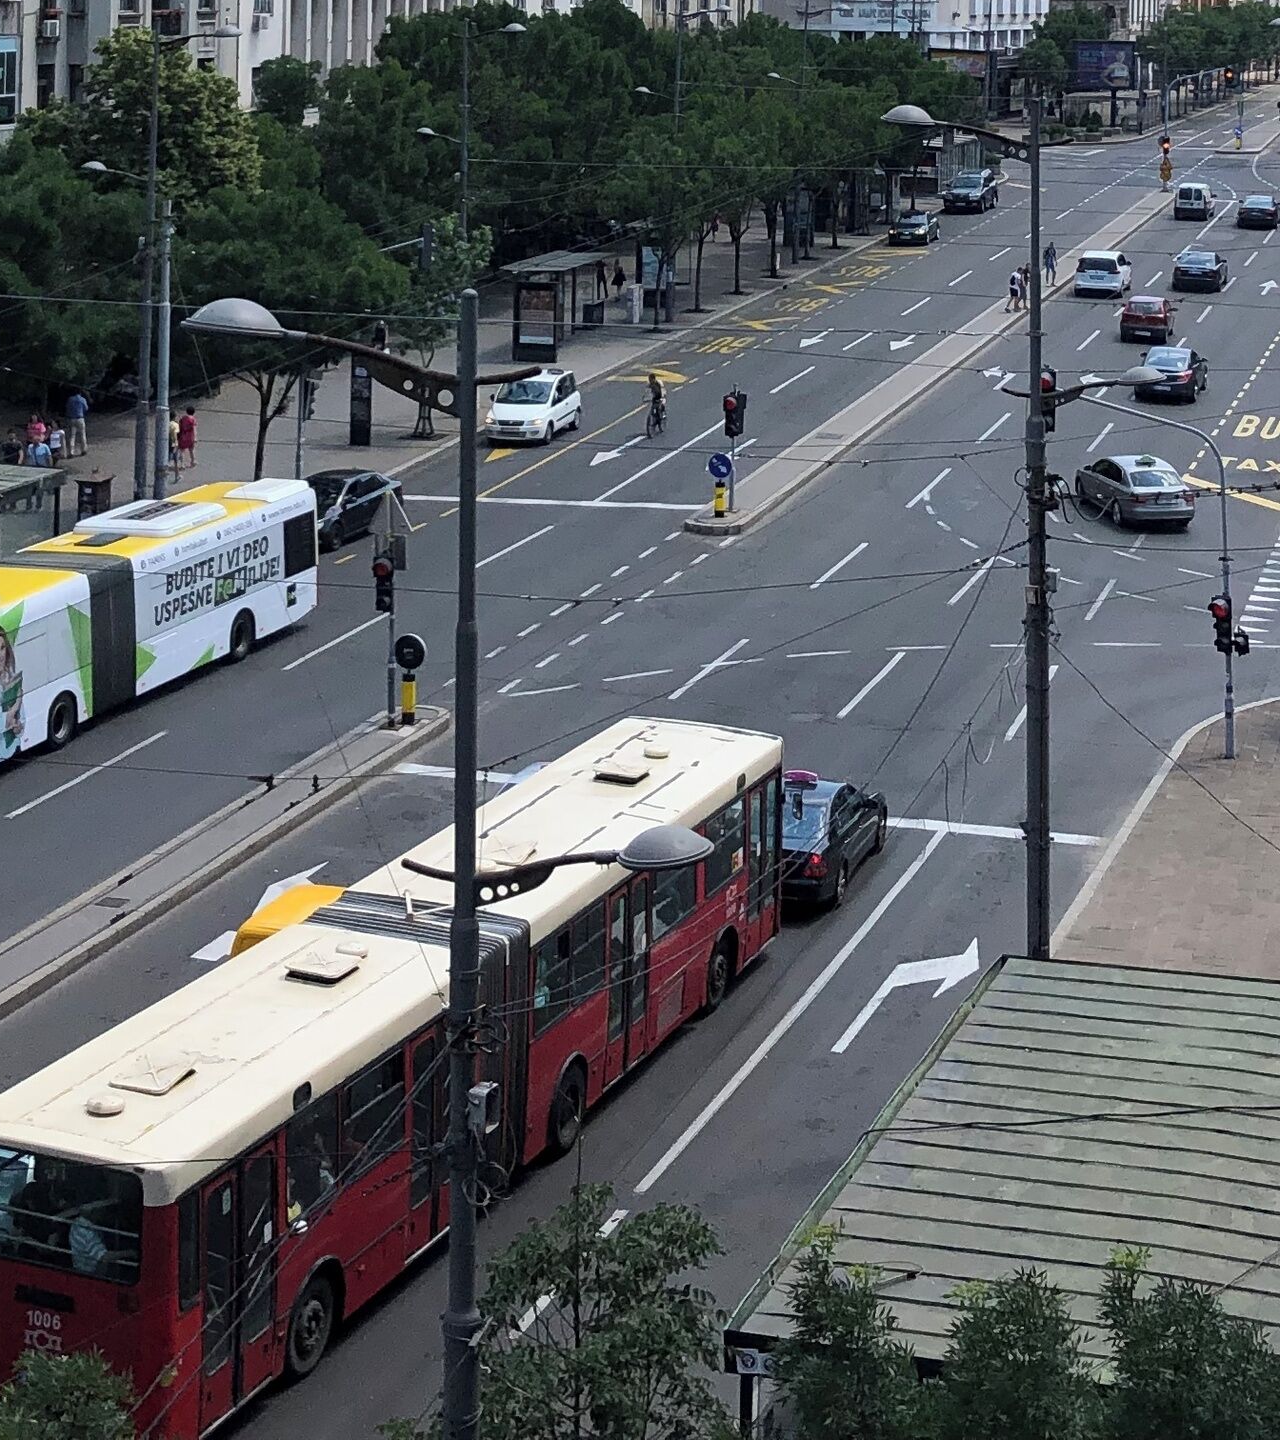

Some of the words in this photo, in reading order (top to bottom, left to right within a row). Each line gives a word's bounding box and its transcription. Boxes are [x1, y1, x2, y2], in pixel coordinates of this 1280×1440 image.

[166, 556, 215, 595] BUDITE
[154, 583, 214, 626] USPEŠNE
[26, 1310, 61, 1330] 1006
